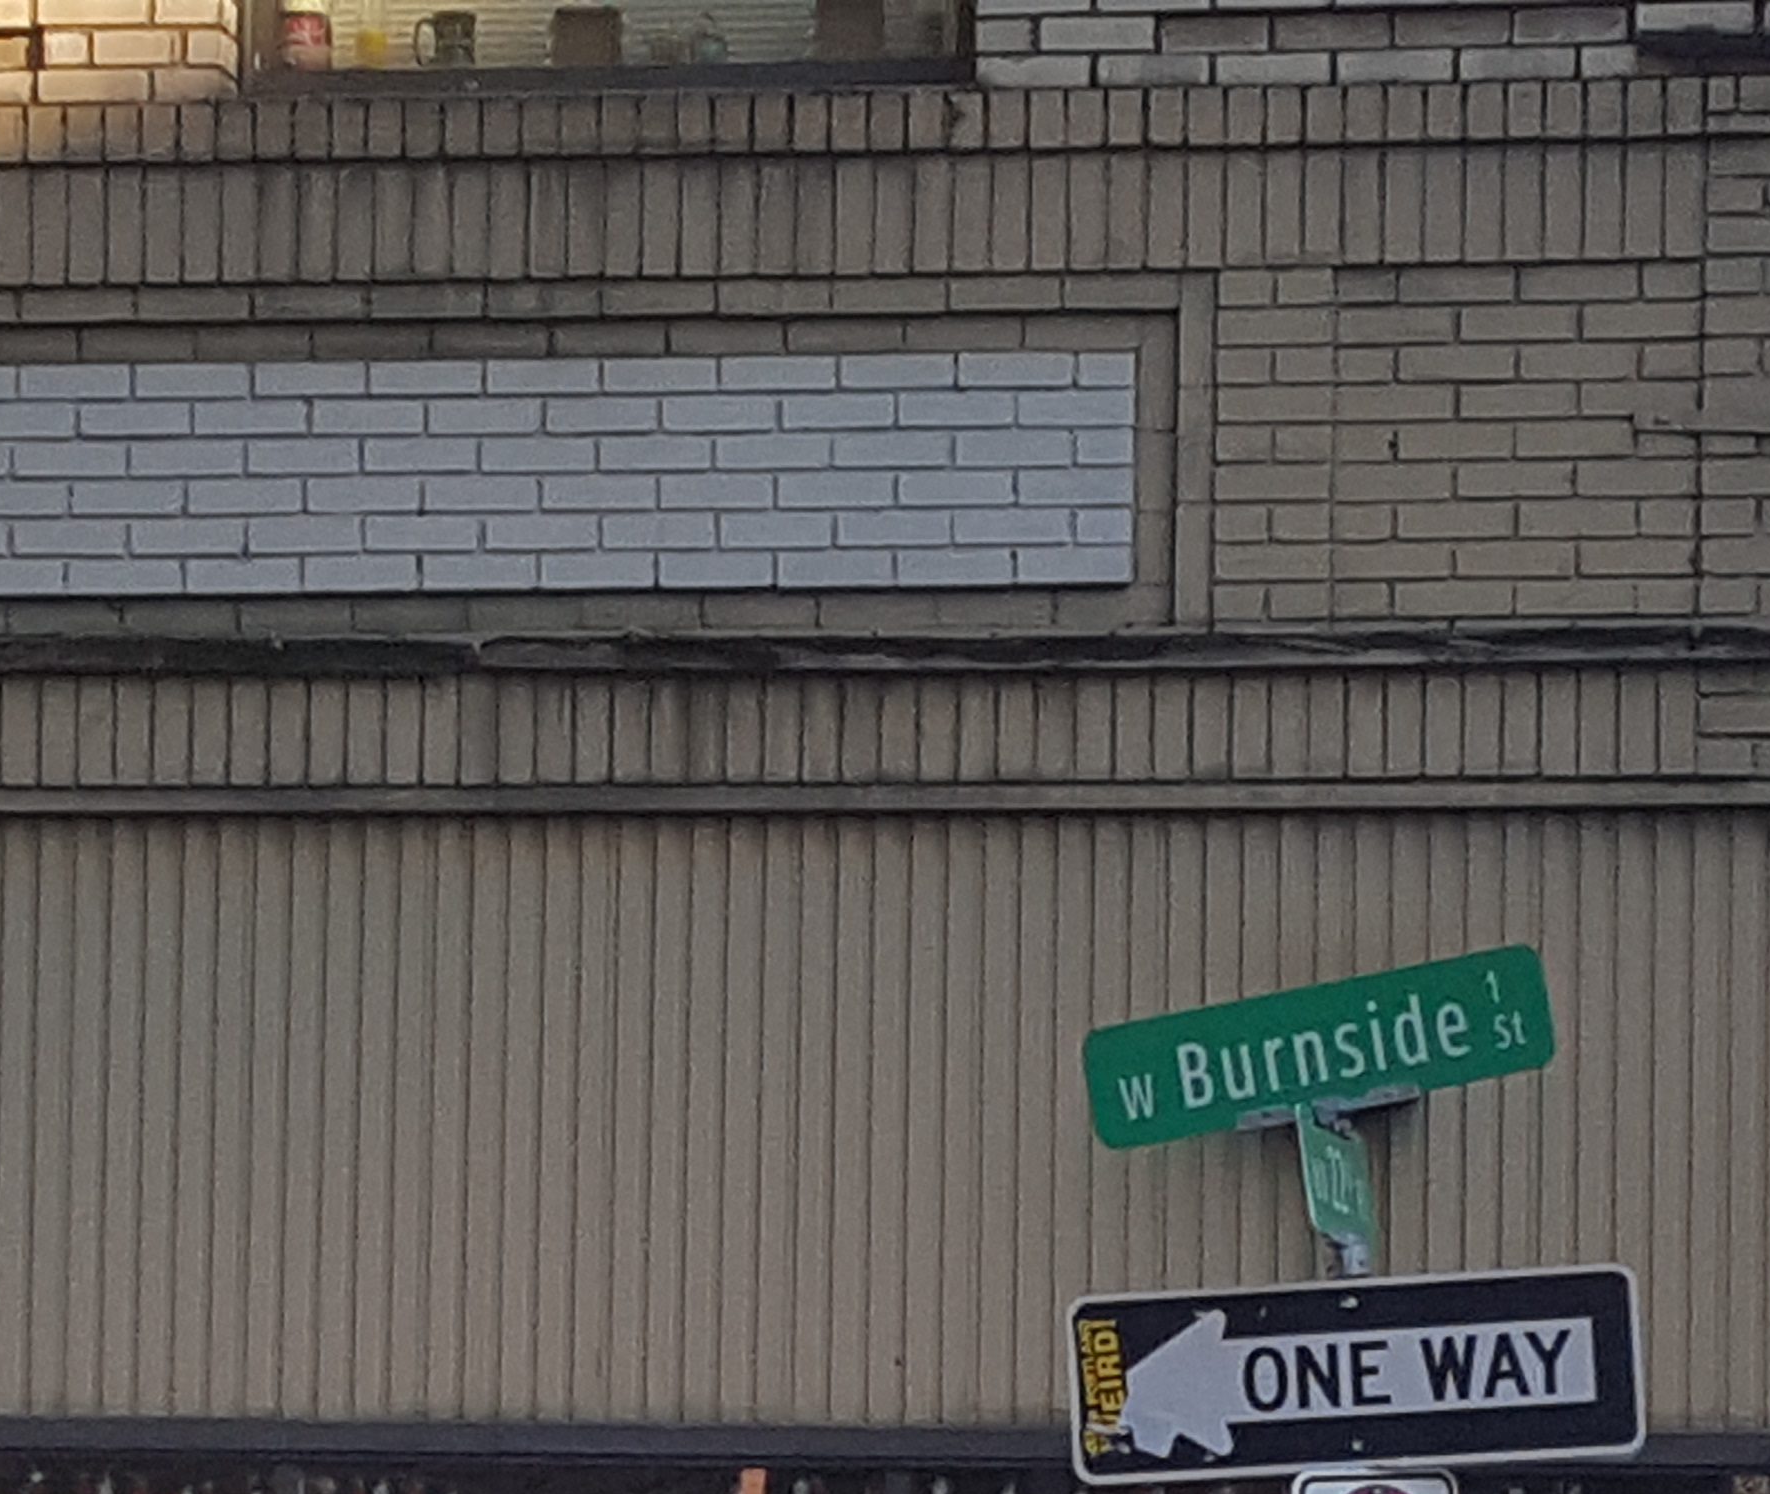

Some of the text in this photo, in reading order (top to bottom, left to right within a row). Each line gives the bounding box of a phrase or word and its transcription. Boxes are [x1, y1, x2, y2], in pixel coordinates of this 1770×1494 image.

[1118, 993, 1527, 1122] W Burnside St
[1242, 1329, 1572, 1412] ONE WAY
